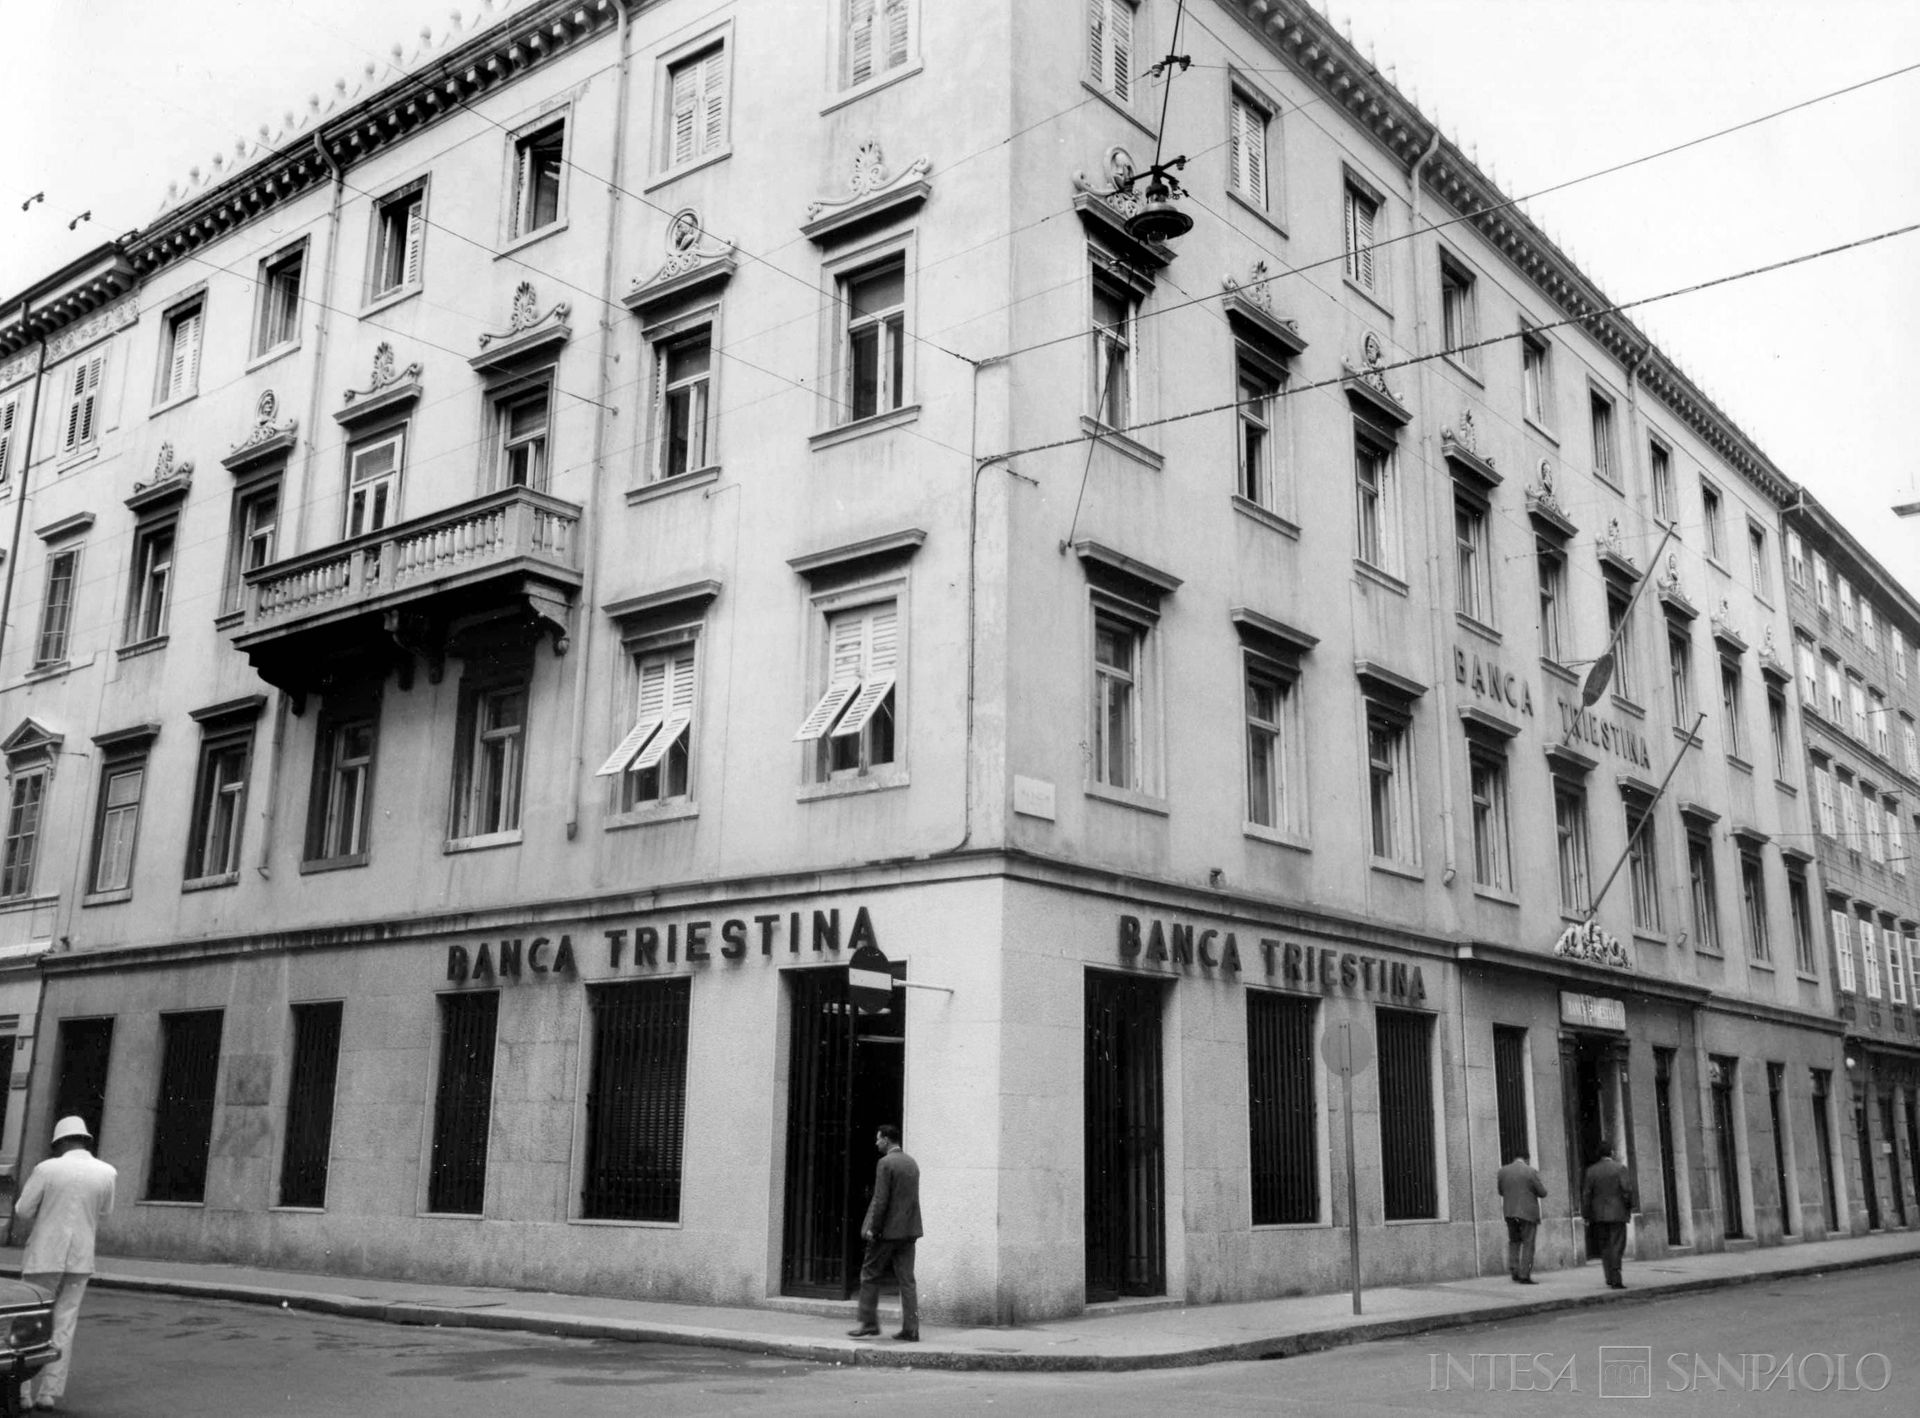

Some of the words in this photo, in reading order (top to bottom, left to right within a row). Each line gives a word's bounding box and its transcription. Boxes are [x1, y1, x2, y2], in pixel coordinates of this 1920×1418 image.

[1453, 644, 1534, 718] BANCA
[1557, 697, 1651, 770] TRIESTINA
[446, 934, 577, 981] BANCA
[604, 906, 880, 968] TRIESTINA
[1119, 914, 1242, 973] BANCA
[1260, 937, 1427, 1000] TRIESTINA
